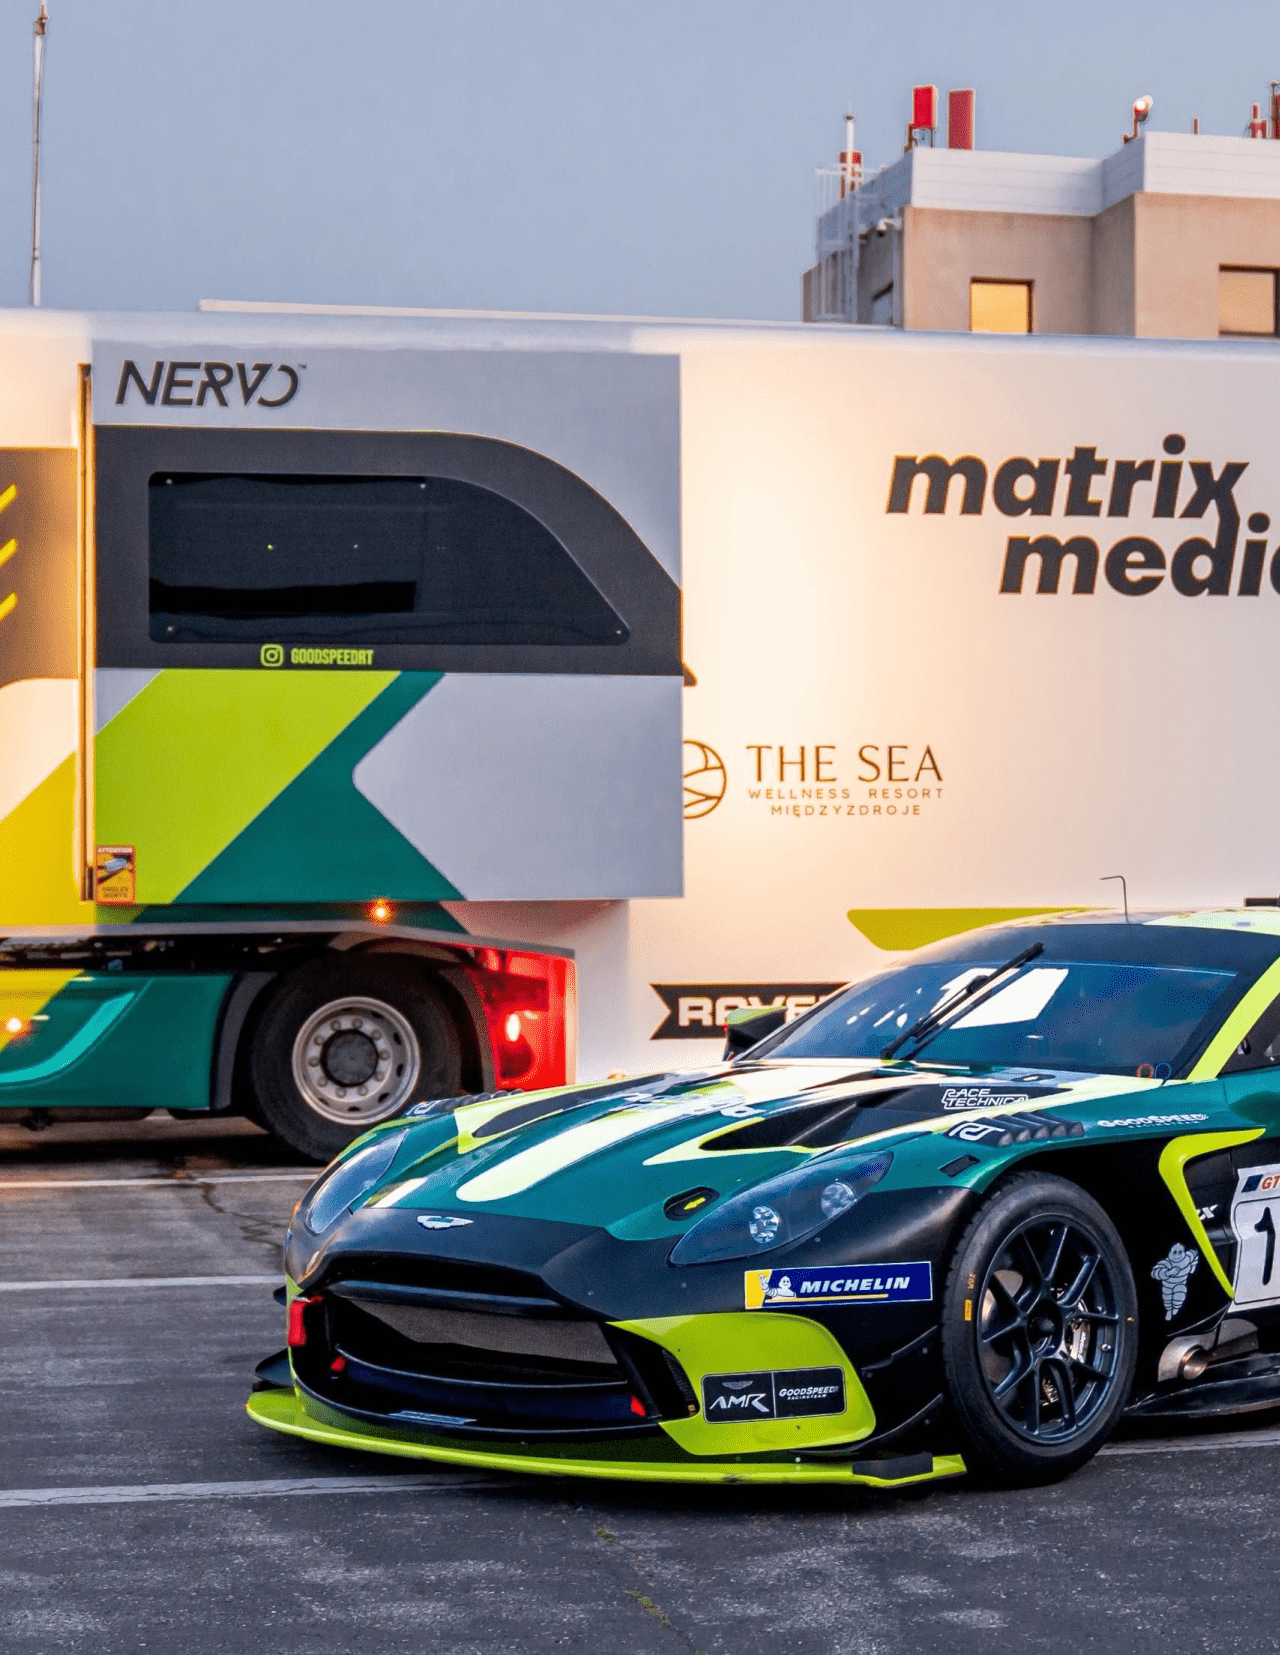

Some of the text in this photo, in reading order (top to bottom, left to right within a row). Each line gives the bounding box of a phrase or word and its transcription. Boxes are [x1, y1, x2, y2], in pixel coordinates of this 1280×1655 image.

[885, 433, 1250, 518] matrix
[291, 648, 374, 665] GOODSPEEDRT
[746, 744, 943, 782] THE SEA
[748, 788, 943, 799] WELLNESS RESORT
[770, 804, 921, 818] MIĘDZYZDROJE
[946, 1088, 991, 1098] RACE
[800, 1276, 911, 1294] MICHELIN
[779, 1386, 838, 1397] GOODSPEED
[709, 1393, 770, 1412] AMR
